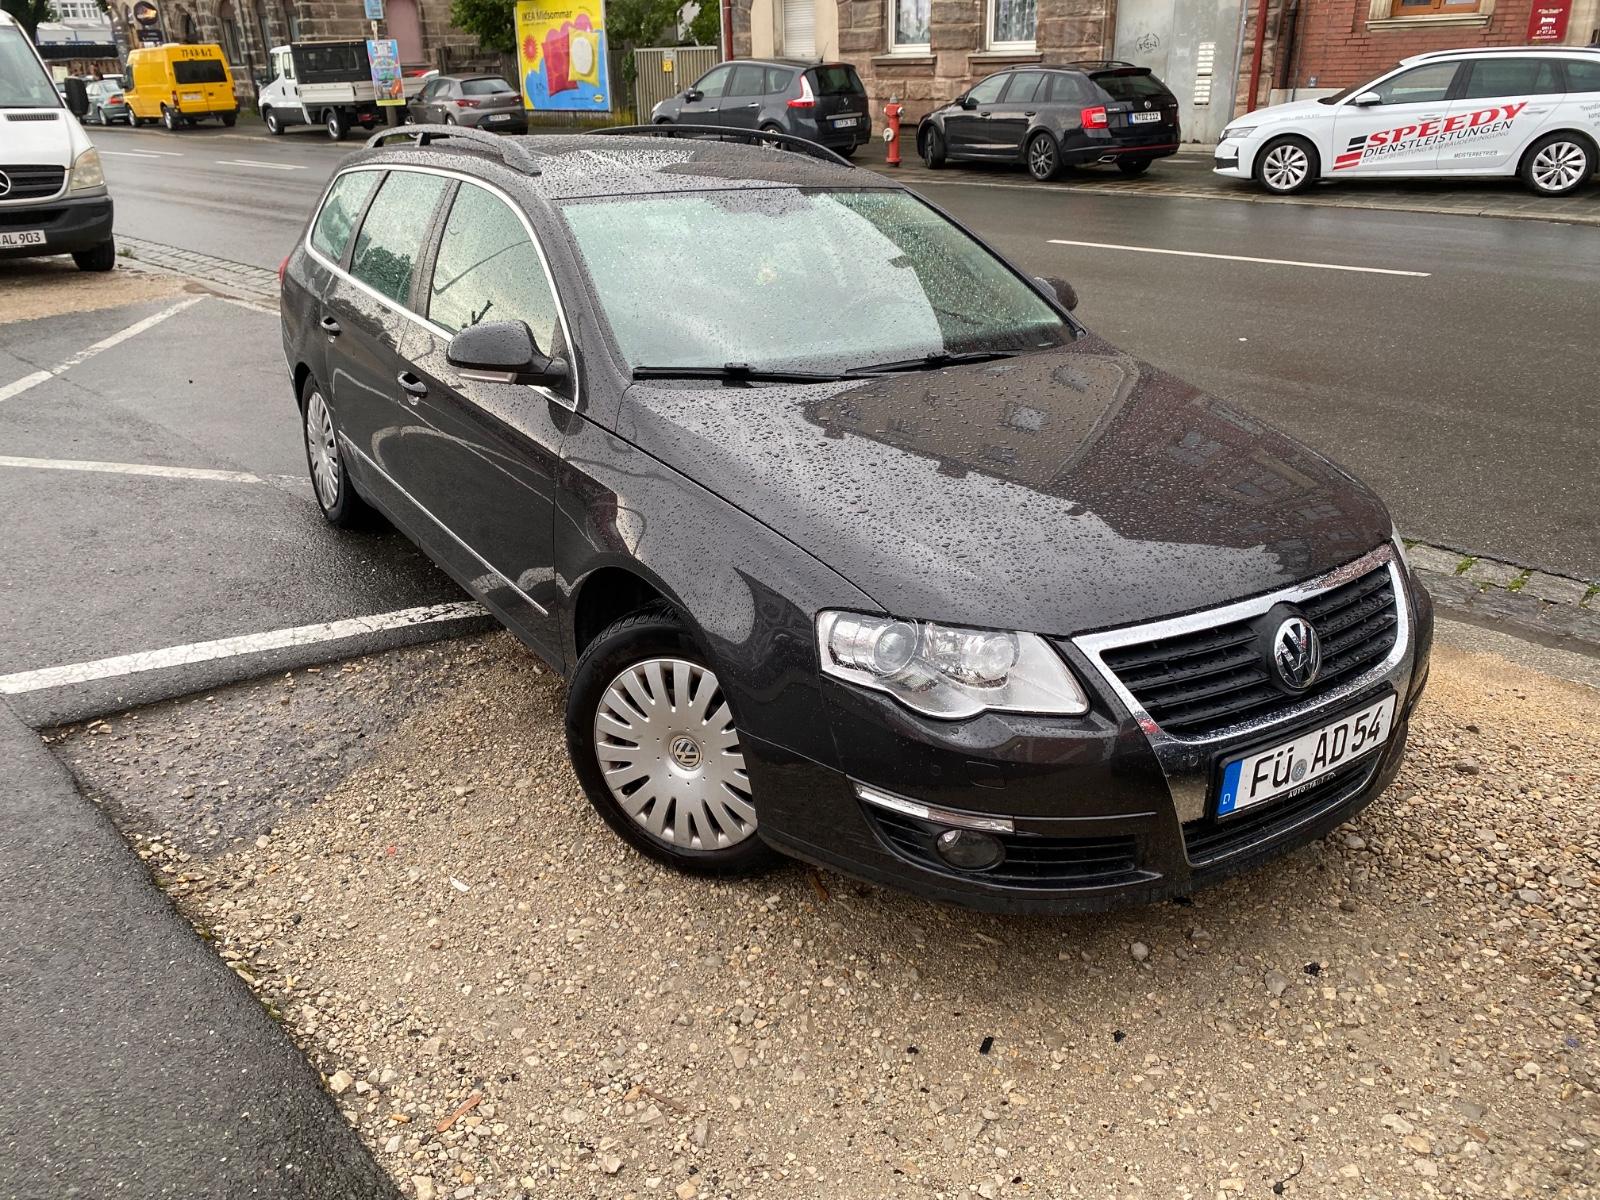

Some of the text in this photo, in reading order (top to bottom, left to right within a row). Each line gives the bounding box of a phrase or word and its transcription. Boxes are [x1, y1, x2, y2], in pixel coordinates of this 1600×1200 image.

[522, 12, 536, 22] IKEA
[536, 10, 573, 20] Midsommar
[1367, 101, 1528, 148] SPEEDY
[1363, 119, 1514, 158] DIENSTLEISTUNGEN
[1454, 149, 1499, 159] MEISTERBETRIEB
[2, 232, 41, 245] AL 903
[1250, 705, 1383, 798] FÜ AD 54
